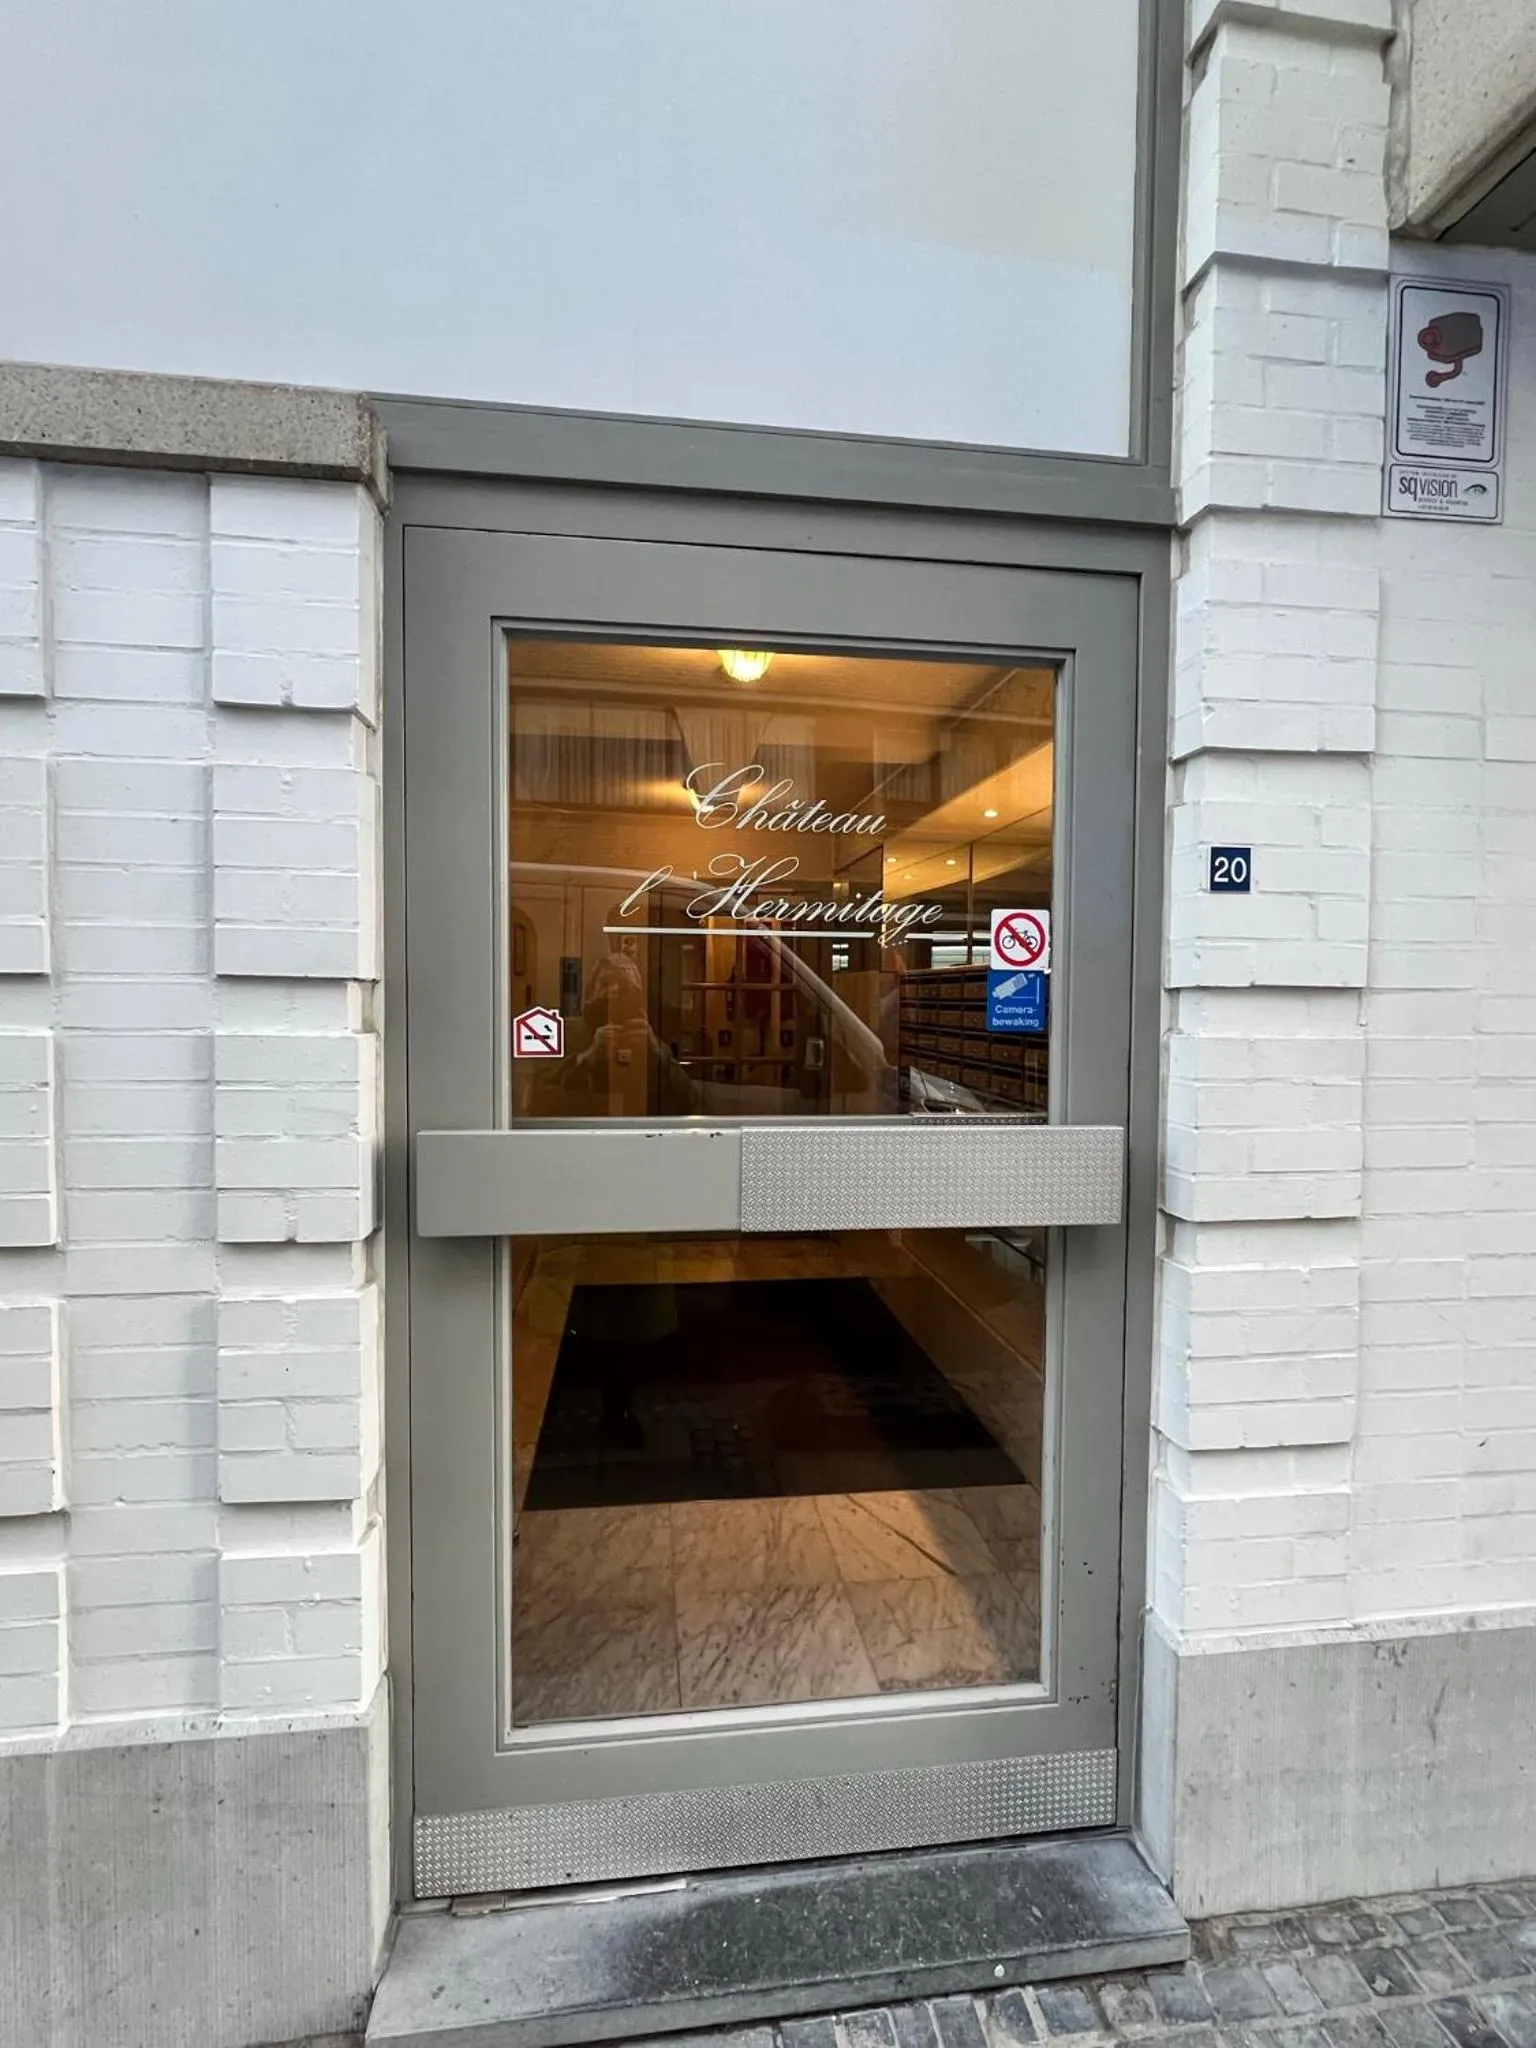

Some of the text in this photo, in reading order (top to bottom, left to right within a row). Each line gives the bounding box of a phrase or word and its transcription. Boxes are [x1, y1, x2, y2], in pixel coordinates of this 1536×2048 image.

[686, 762, 887, 835] Château
[1214, 856, 1247, 883] 20
[992, 1017, 1039, 1027] bewaking
